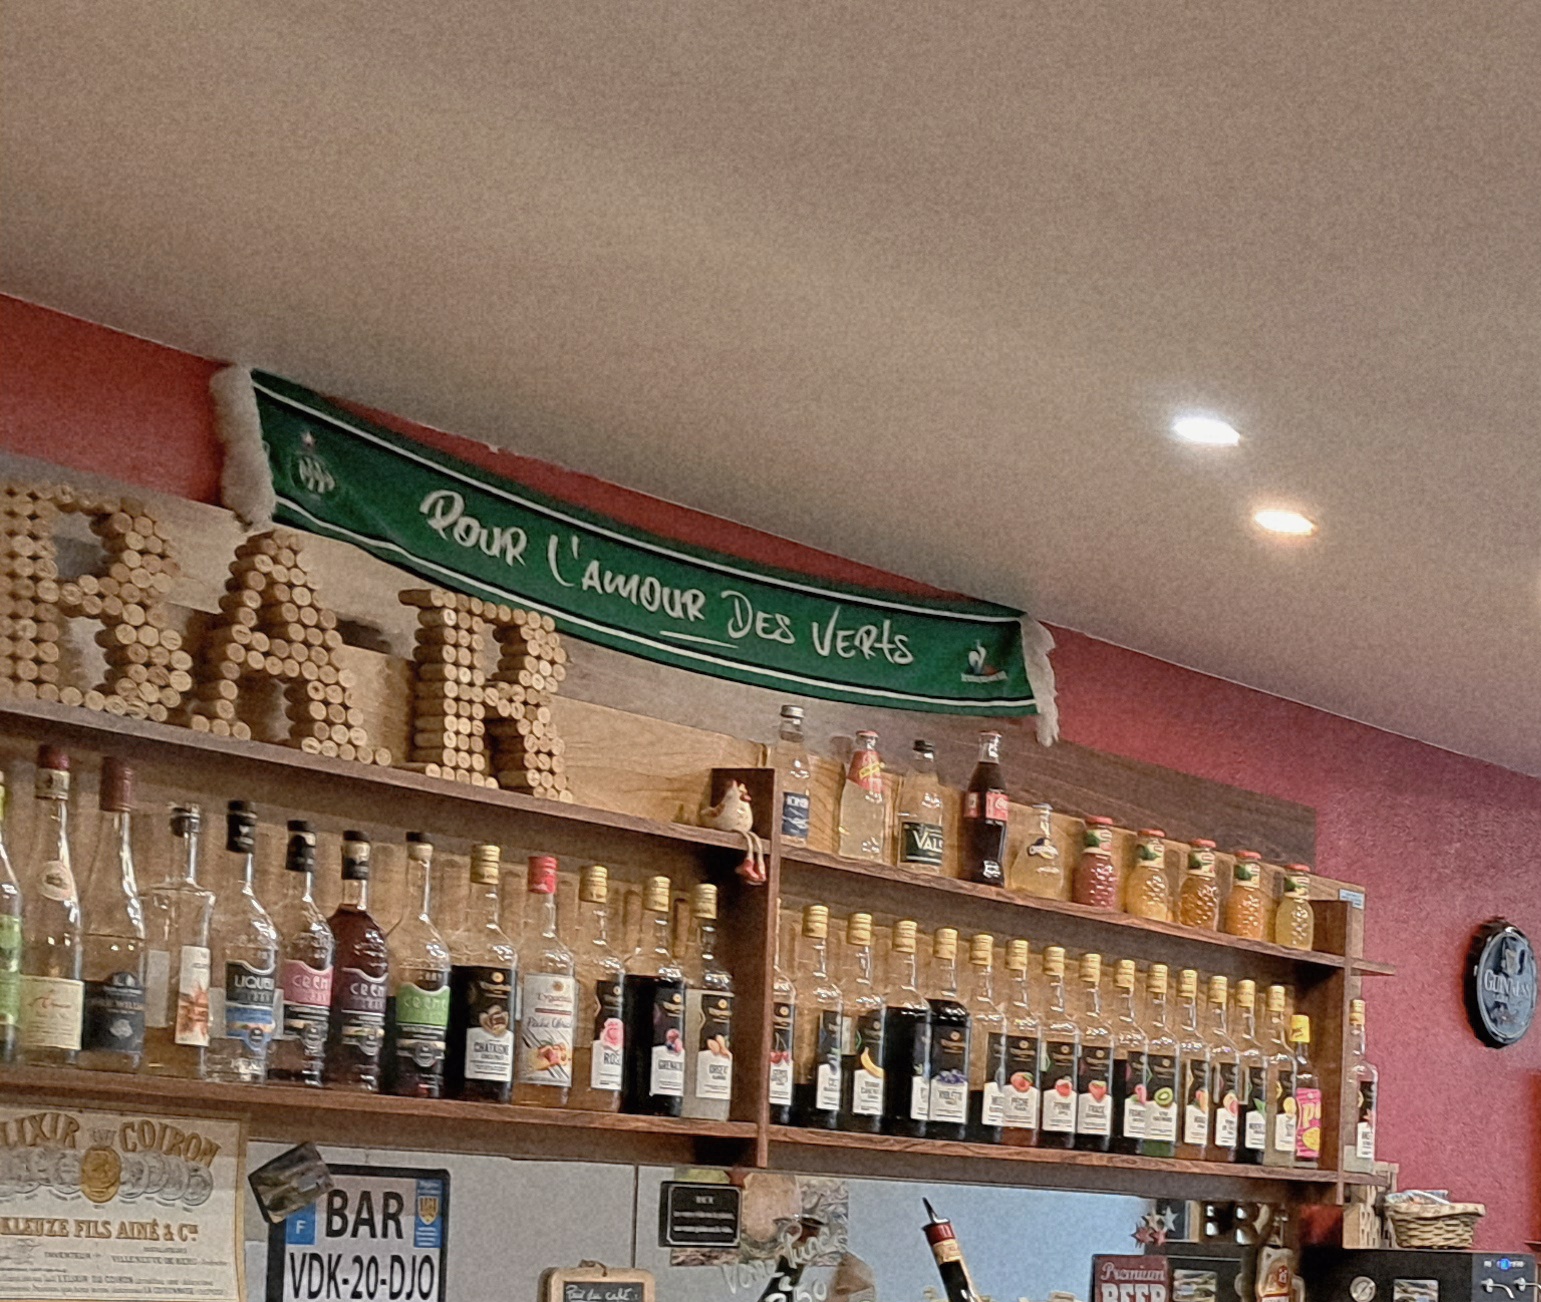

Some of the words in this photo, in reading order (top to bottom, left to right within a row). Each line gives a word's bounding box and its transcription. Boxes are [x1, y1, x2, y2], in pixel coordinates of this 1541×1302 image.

[295, 1219, 307, 1235] F
[326, 1188, 404, 1240] BAR
[289, 1251, 436, 1301] VDK-20-DJO
